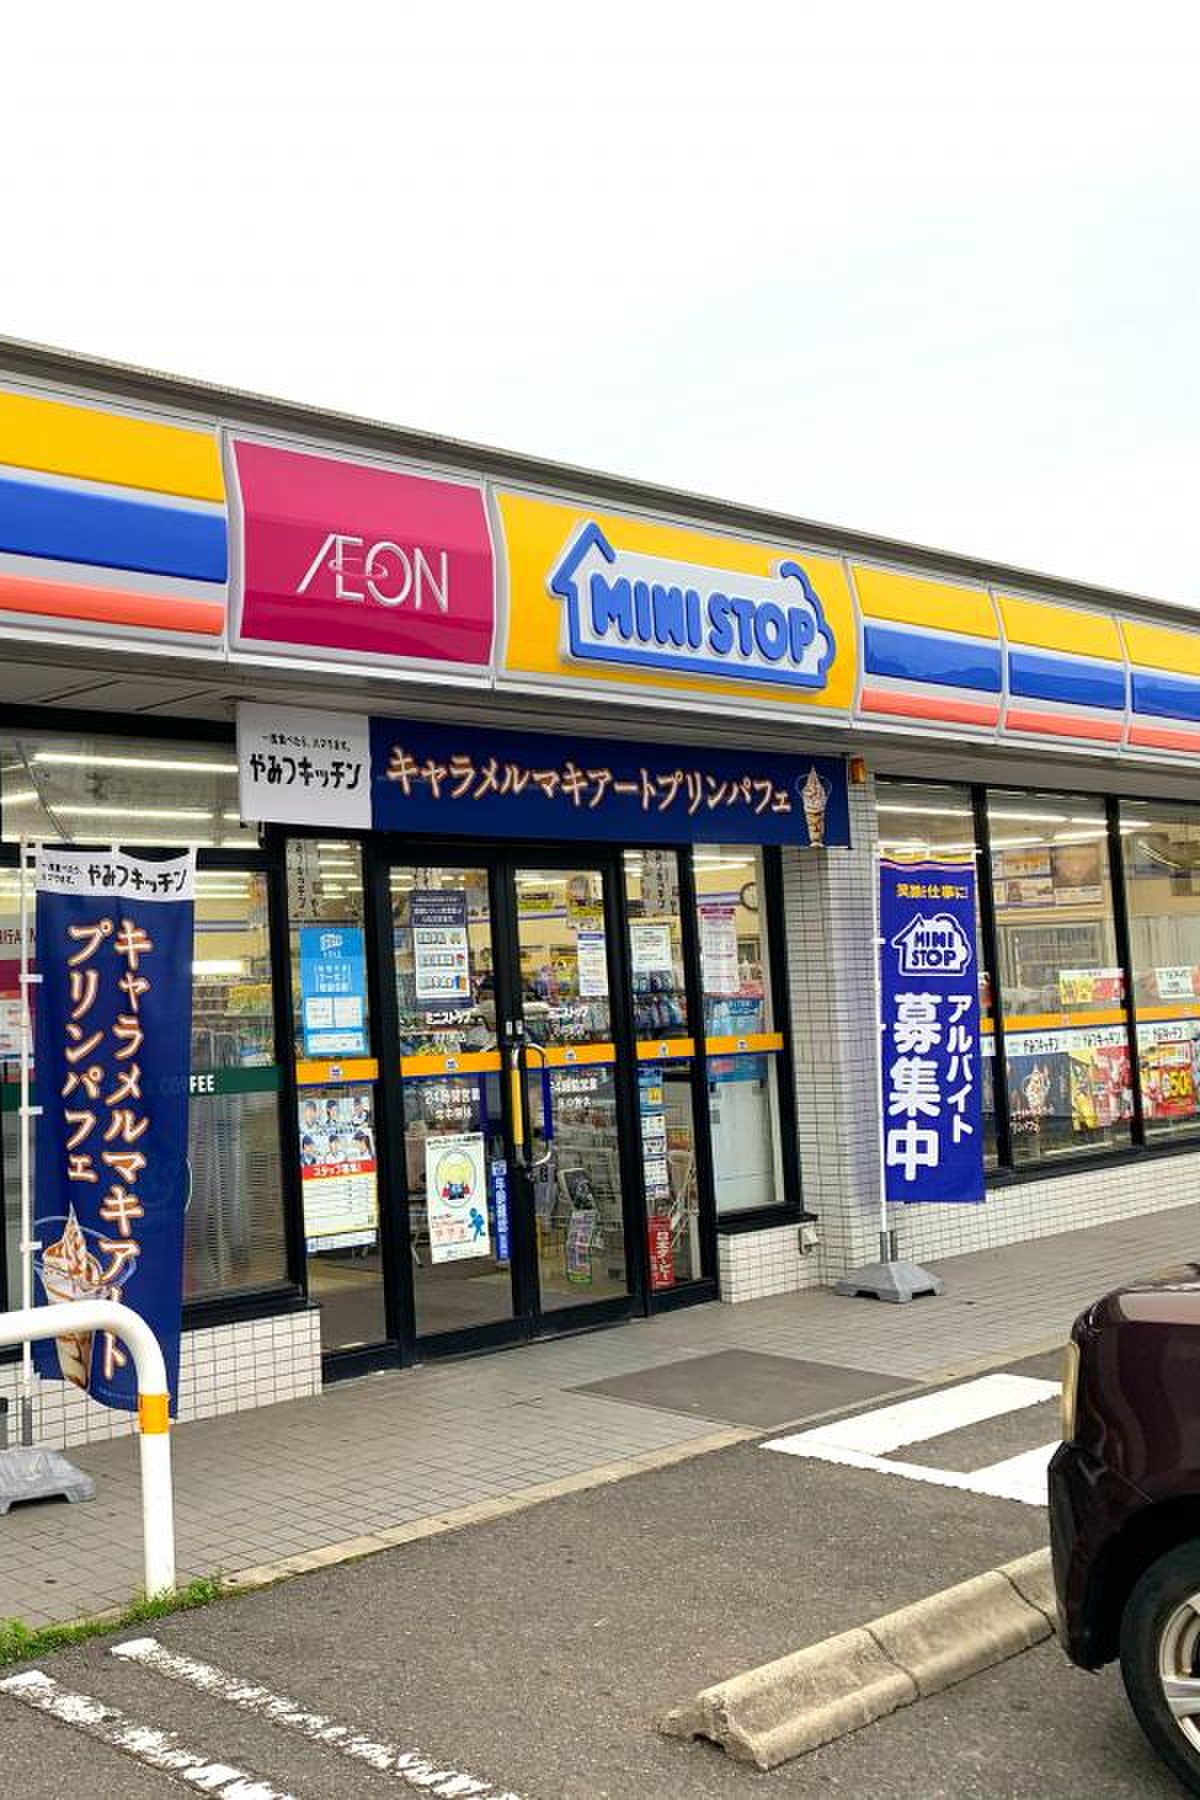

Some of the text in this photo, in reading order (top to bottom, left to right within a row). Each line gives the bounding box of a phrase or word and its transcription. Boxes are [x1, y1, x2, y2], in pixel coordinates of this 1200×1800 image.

[590, 572, 816, 665] MINI STOP
[249, 753, 362, 790] やみつキッチン
[386, 745, 792, 815] キャラメルマキアートプリンパフェ
[87, 863, 188, 893] やみつキッチン
[911, 949, 957, 966] STOP
[62, 919, 112, 1183] プリンパフェ
[189, 1074, 215, 1093] FEE
[886, 991, 942, 1181] 募集中
[945, 994, 974, 1143] アルバイト
